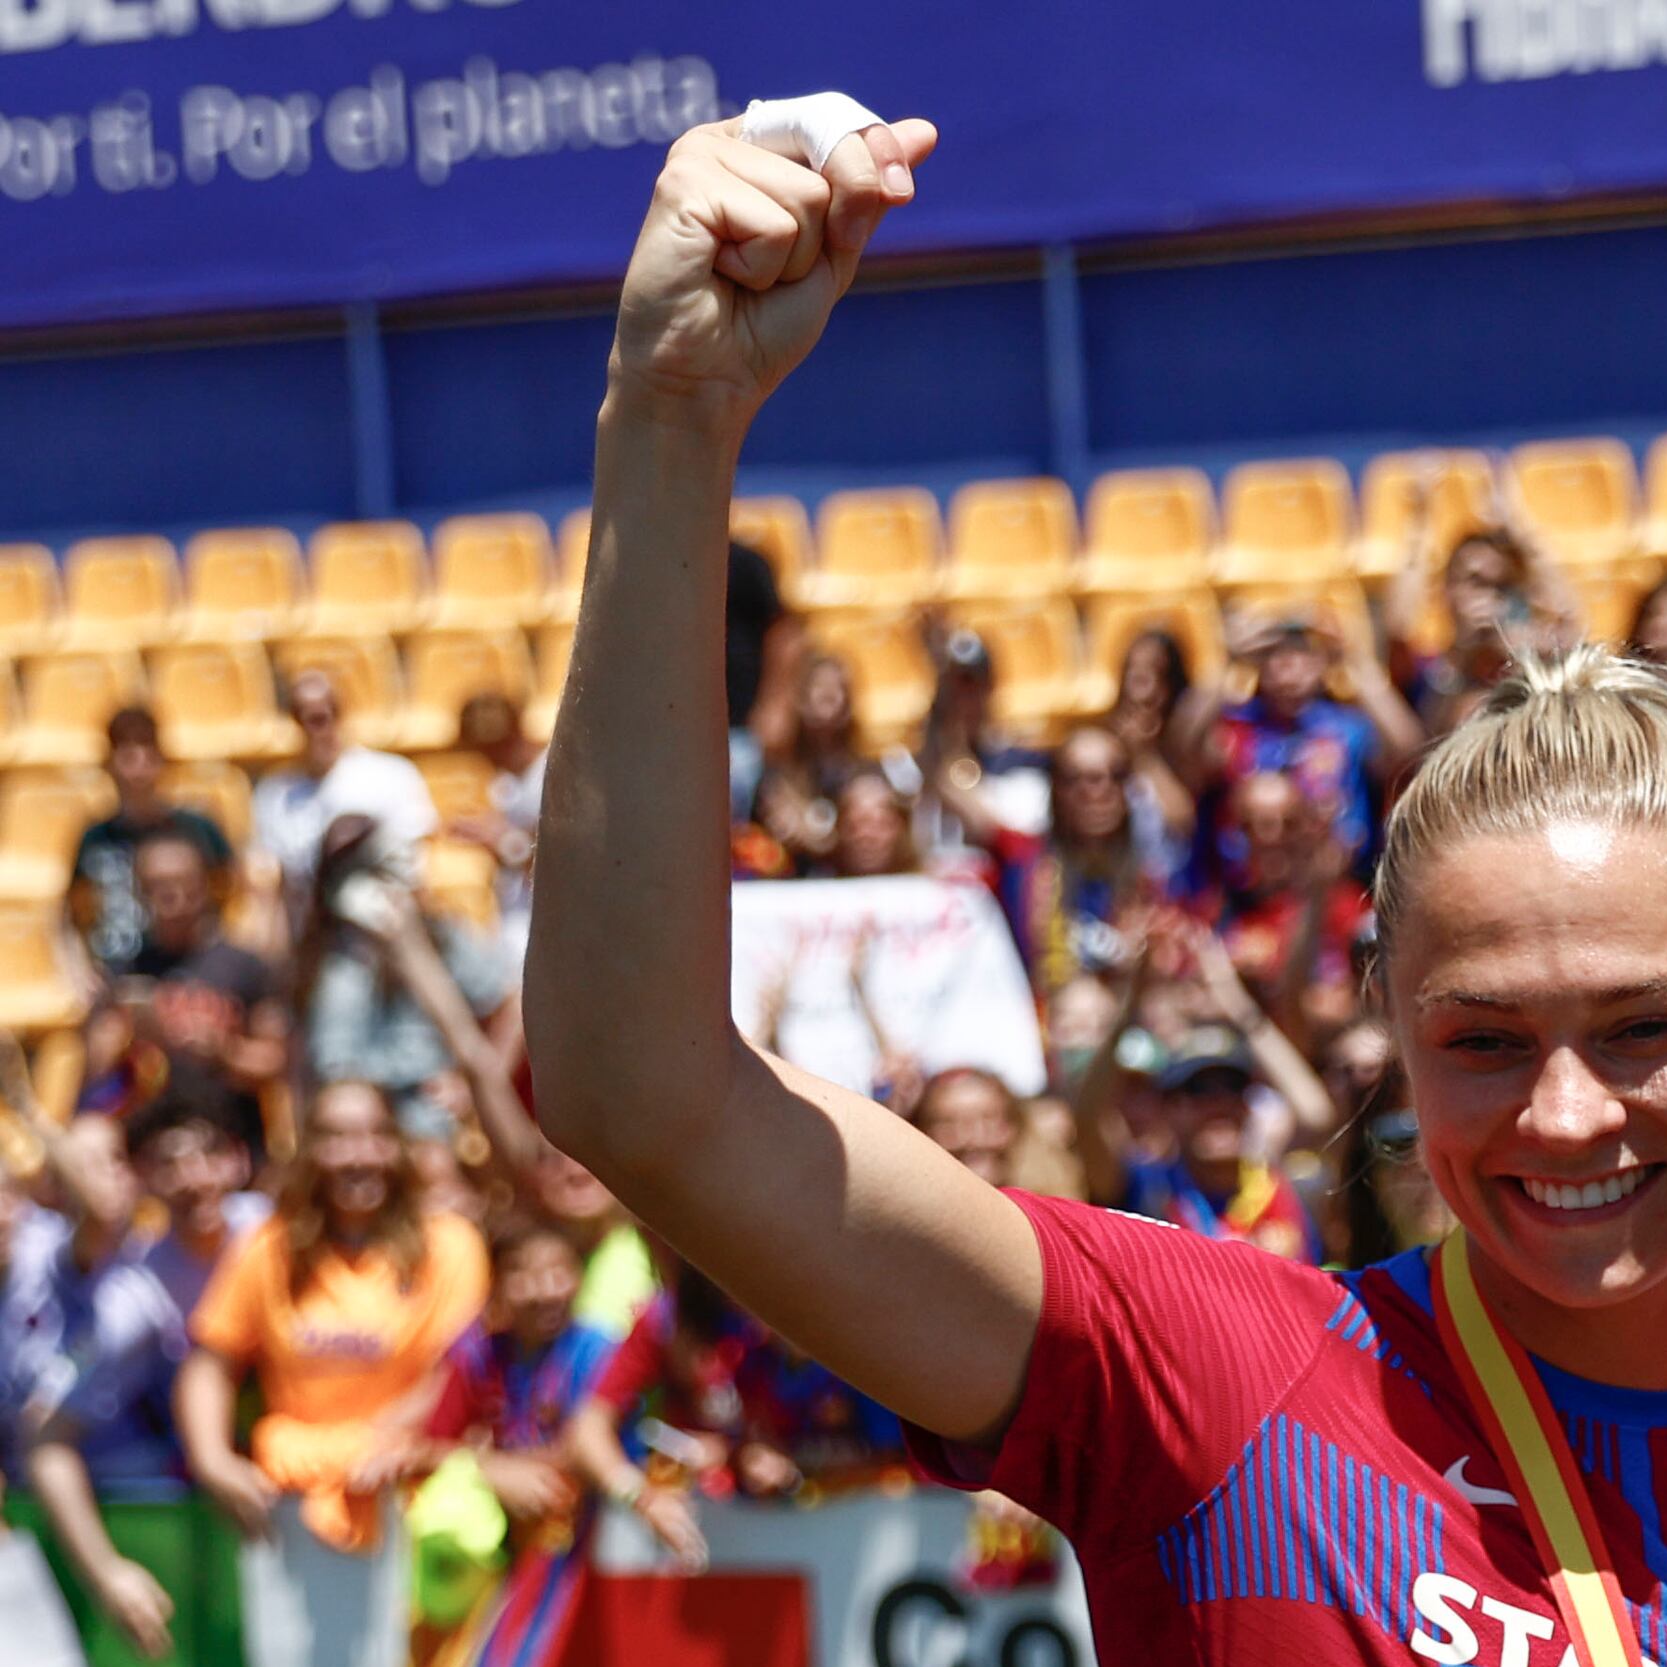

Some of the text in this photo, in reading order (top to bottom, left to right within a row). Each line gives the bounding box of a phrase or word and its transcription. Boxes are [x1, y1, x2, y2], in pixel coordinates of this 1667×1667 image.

[0, 115, 82, 200] or
[180, 85, 318, 185] Por
[323, 63, 408, 173] el
